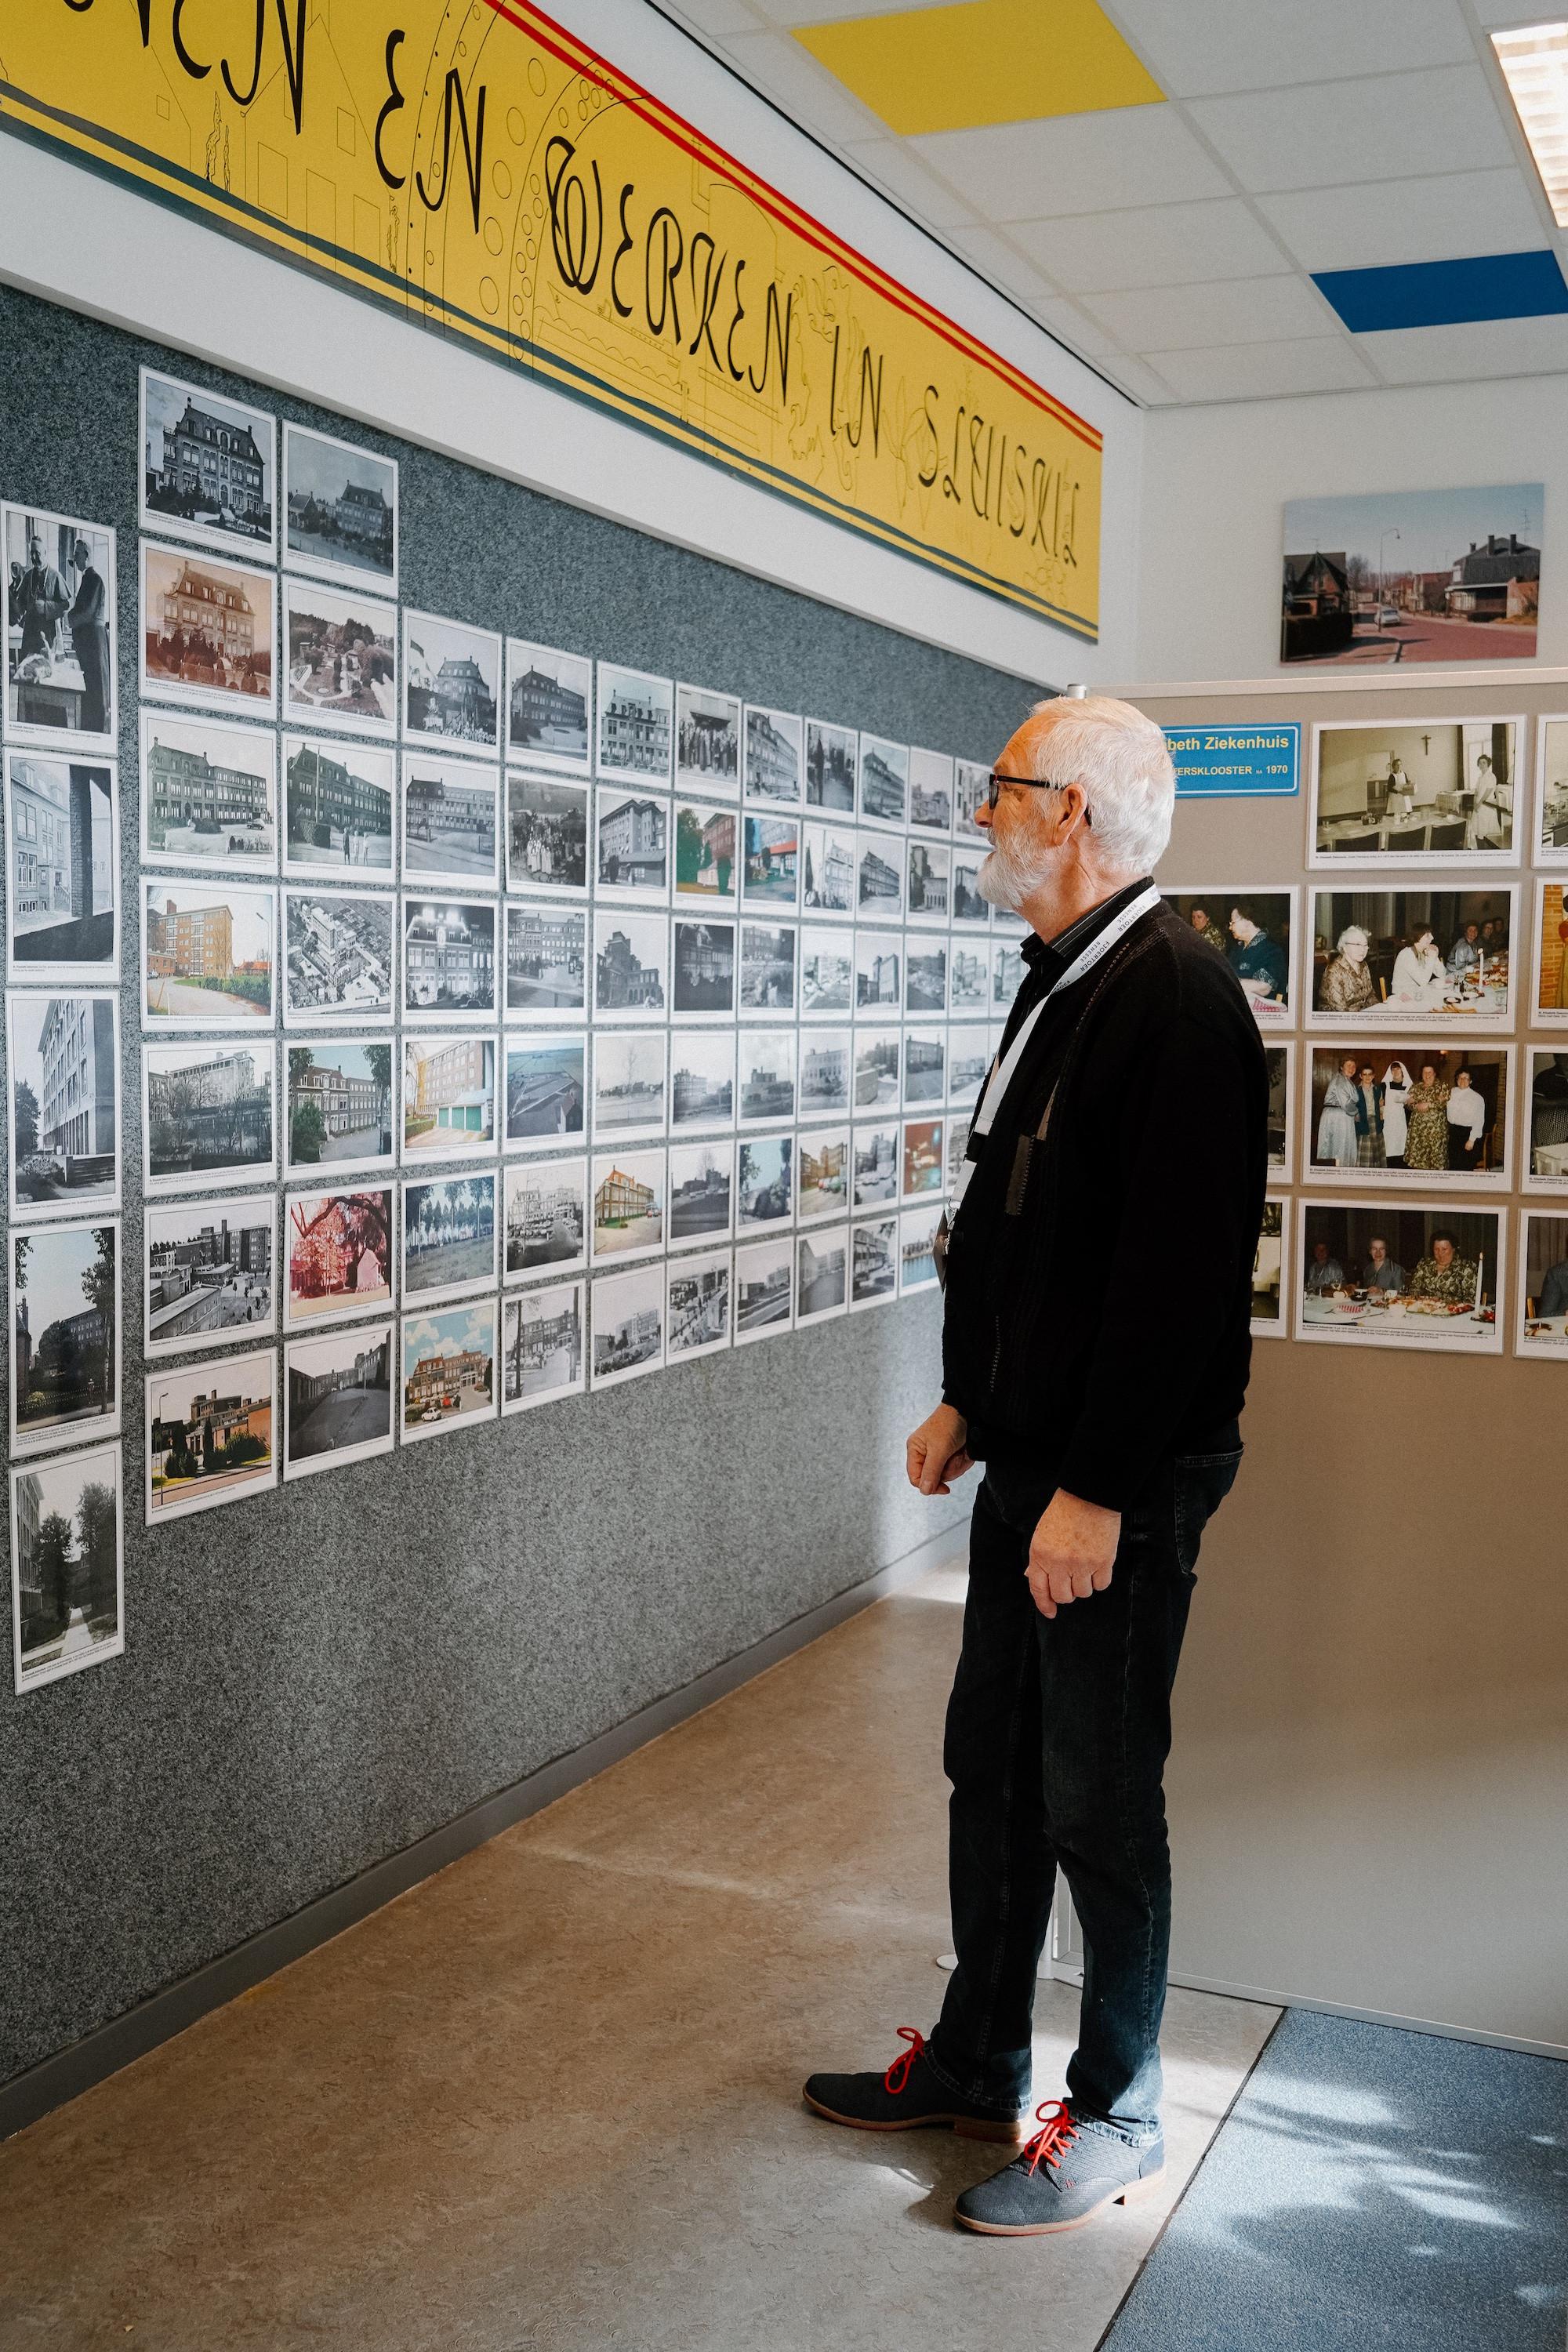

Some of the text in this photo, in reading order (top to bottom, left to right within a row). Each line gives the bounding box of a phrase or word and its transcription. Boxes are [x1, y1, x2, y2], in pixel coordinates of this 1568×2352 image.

[375, 30, 486, 234] EN
[545, 136, 793, 406] WERKEN
[830, 325, 883, 459] IN
[1167, 735, 1290, 751] beth Ziekenhuis
[1266, 765, 1288, 774] 1970
[1080, 941, 1101, 963] RENESSE
[1080, 941, 1110, 972] FJOERTOER
